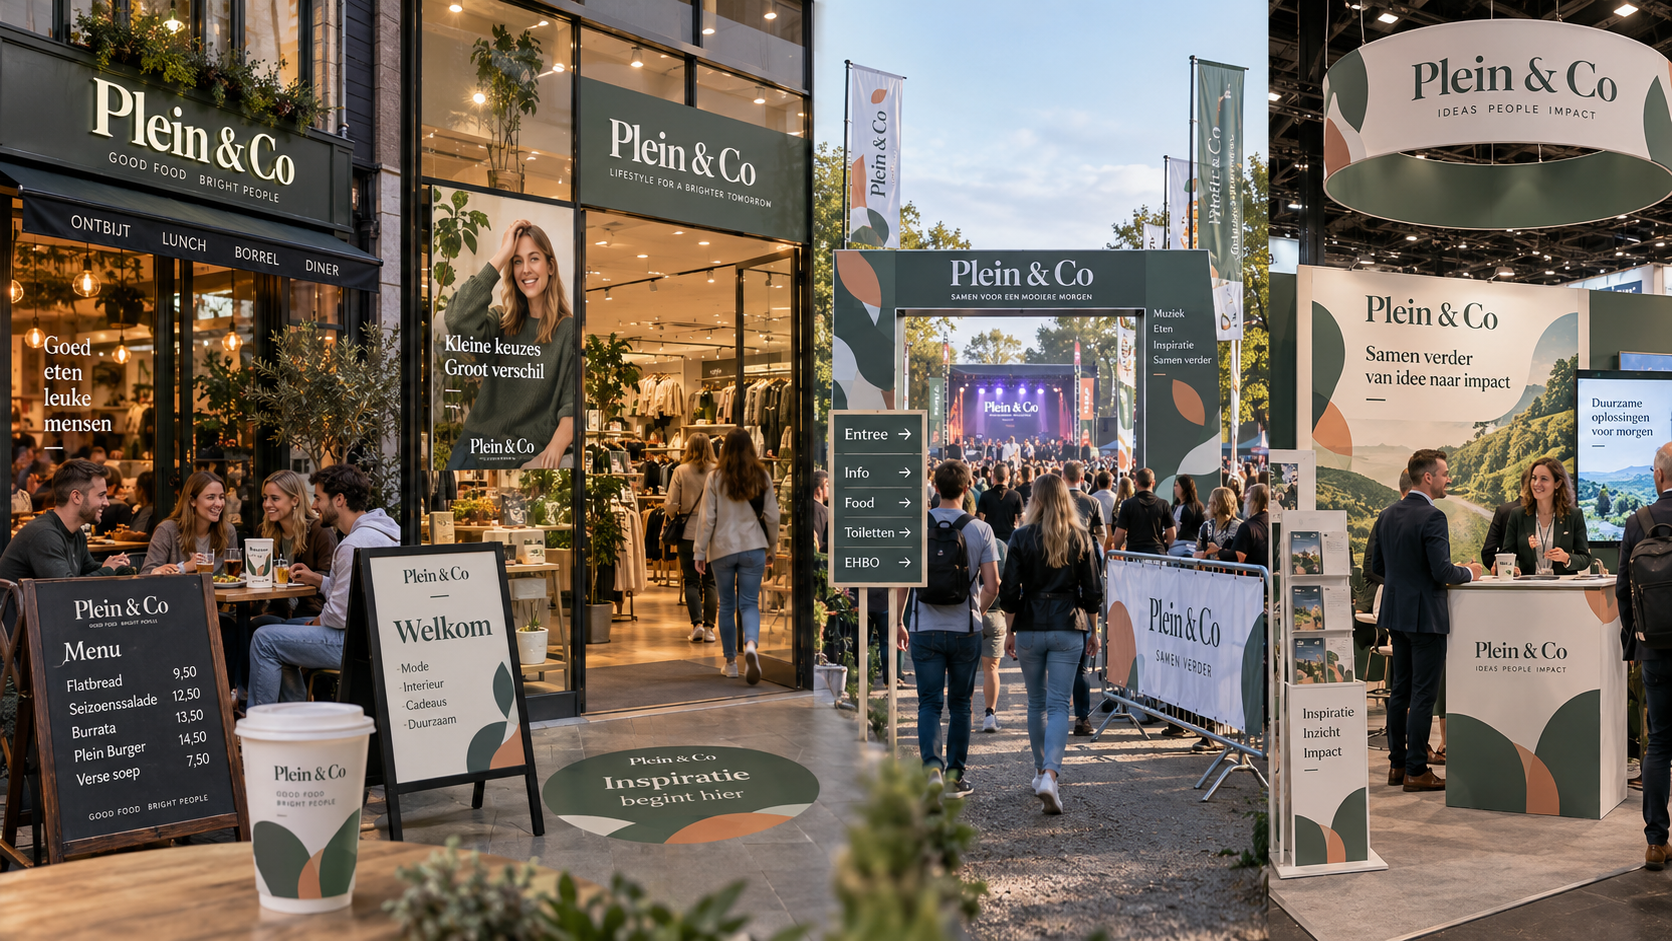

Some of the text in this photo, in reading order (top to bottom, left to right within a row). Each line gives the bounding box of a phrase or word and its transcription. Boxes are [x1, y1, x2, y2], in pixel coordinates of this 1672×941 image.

[1412, 56, 1618, 103] Plein & Co
[1438, 104, 1597, 120] IDEAS PEOPLE IMPACT
[92, 77, 296, 186] Plein & Co
[609, 118, 757, 187] Plein & Co
[870, 110, 887, 198] Plein & Co
[108, 151, 279, 203] GOOD FOOD BRIGHT PEOPLE
[610, 168, 654, 184] LIFESTYLE
[658, 178, 674, 189] FOR
[677, 182, 682, 190] A
[686, 184, 724, 199] BRIGHTER
[71, 214, 339, 277] ONTBIJT LUNCH BORREL DINER
[950, 260, 1094, 287] Plein & Co
[1154, 308, 1185, 319] Muziek
[1366, 295, 1499, 331] Plein & Co
[1154, 324, 1173, 333] Eten
[44, 335, 91, 355] Goed
[445, 334, 540, 356] Kleine keuzes
[1154, 340, 1194, 352] Inspiratie
[1154, 355, 1212, 365] Samen verder
[1366, 345, 1473, 366] Samen verder
[44, 365, 82, 381] eten
[445, 358, 545, 379] Groot verschil
[1366, 370, 1510, 392] van idee naar impact
[44, 388, 91, 407] leuke
[1592, 398, 1643, 409] Duurzame
[984, 401, 1039, 413] Plein & Co
[44, 417, 112, 432] mensen
[1592, 411, 1650, 425] oplossingen
[845, 428, 888, 441] Entree
[1592, 427, 1653, 439] voor morgen
[470, 438, 535, 454] Plein & Co
[845, 466, 870, 479] Info
[845, 496, 875, 509] Food
[844, 526, 895, 539] Toiletten
[845, 556, 880, 569] EHBO
[403, 566, 469, 585] Plein & Co
[74, 596, 169, 620] Plein & Co
[394, 614, 493, 644] Welkom
[1149, 597, 1220, 648] Plein & Co
[63, 641, 122, 662] Menu
[1475, 642, 1567, 660] Plein & Co
[1155, 650, 1212, 678] SAMEN VERDER
[173, 666, 197, 681] 9,50
[66, 674, 123, 693] Flatbread
[172, 687, 200, 703] 12,50
[69, 694, 158, 716] Seizoenssalade
[1303, 706, 1355, 720] Inspiratie
[176, 709, 204, 724] 13,50
[72, 723, 116, 739] Burrata
[178, 730, 207, 747] 14,50
[1303, 726, 1340, 739] Inzicht
[74, 742, 146, 763] Plein Burger
[186, 753, 210, 769] 7,50
[629, 752, 717, 767] Plein & Co
[1304, 746, 1342, 761] Impact
[76, 766, 140, 787] Verse soep
[274, 764, 346, 782] Plein & Co
[603, 767, 751, 792] Inspiratie
[88, 794, 209, 821] GOOD FOOD BRIGHT PEOPLE
[309, 798, 336, 807] PEOPLE
[620, 788, 744, 809] begint hier
